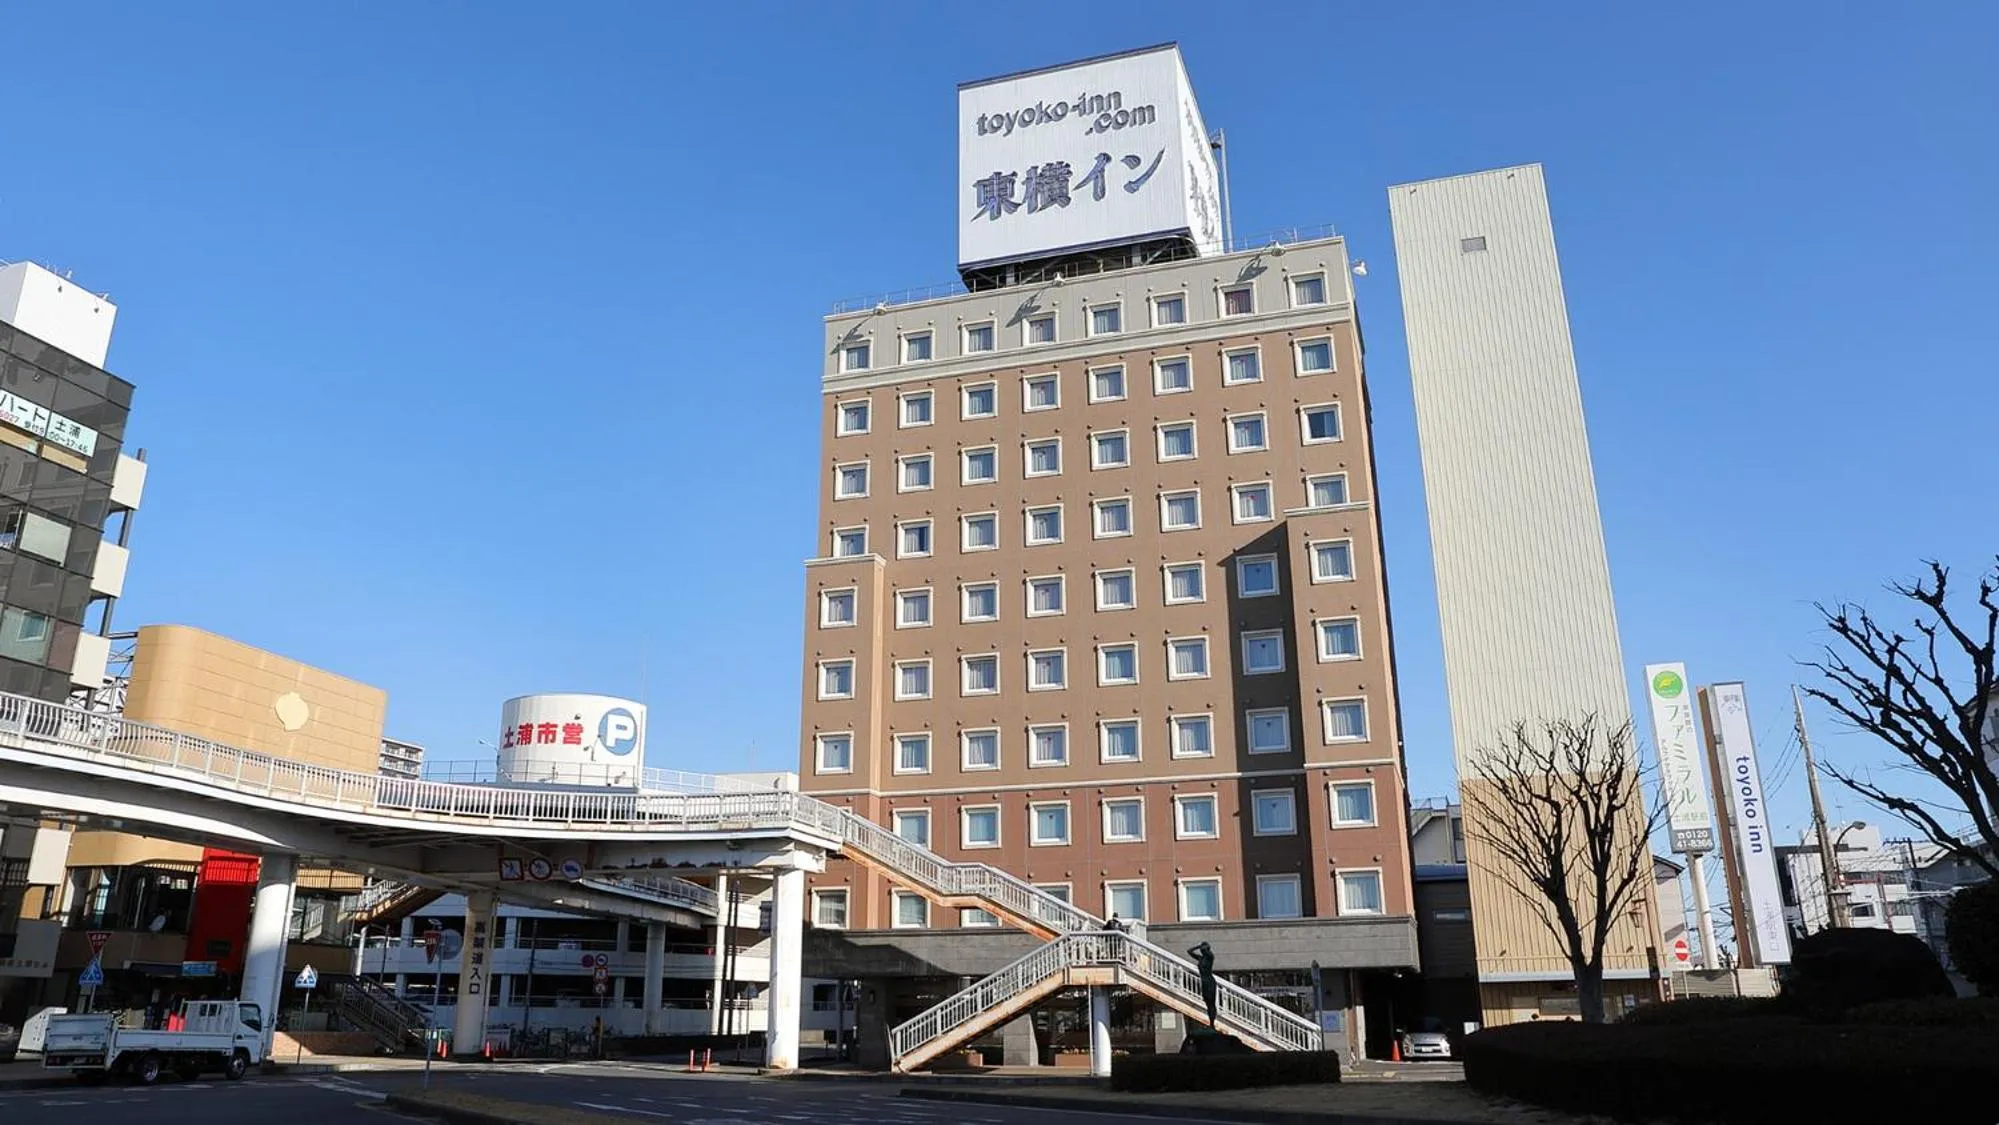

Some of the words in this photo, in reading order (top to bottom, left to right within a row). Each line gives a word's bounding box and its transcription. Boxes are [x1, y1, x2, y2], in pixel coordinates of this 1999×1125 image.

[975, 91, 1122, 136] toyoko-inn
[1085, 103, 1156, 135] .com
[971, 145, 1167, 222] 東横イン
[503, 722, 584, 749] 土浦市営
[606, 714, 634, 747] P
[1664, 704, 1698, 804] ファミラル
[1735, 756, 1764, 820] toyoko
[1685, 830, 1708, 839] 0120
[1748, 823, 1765, 854] inn
